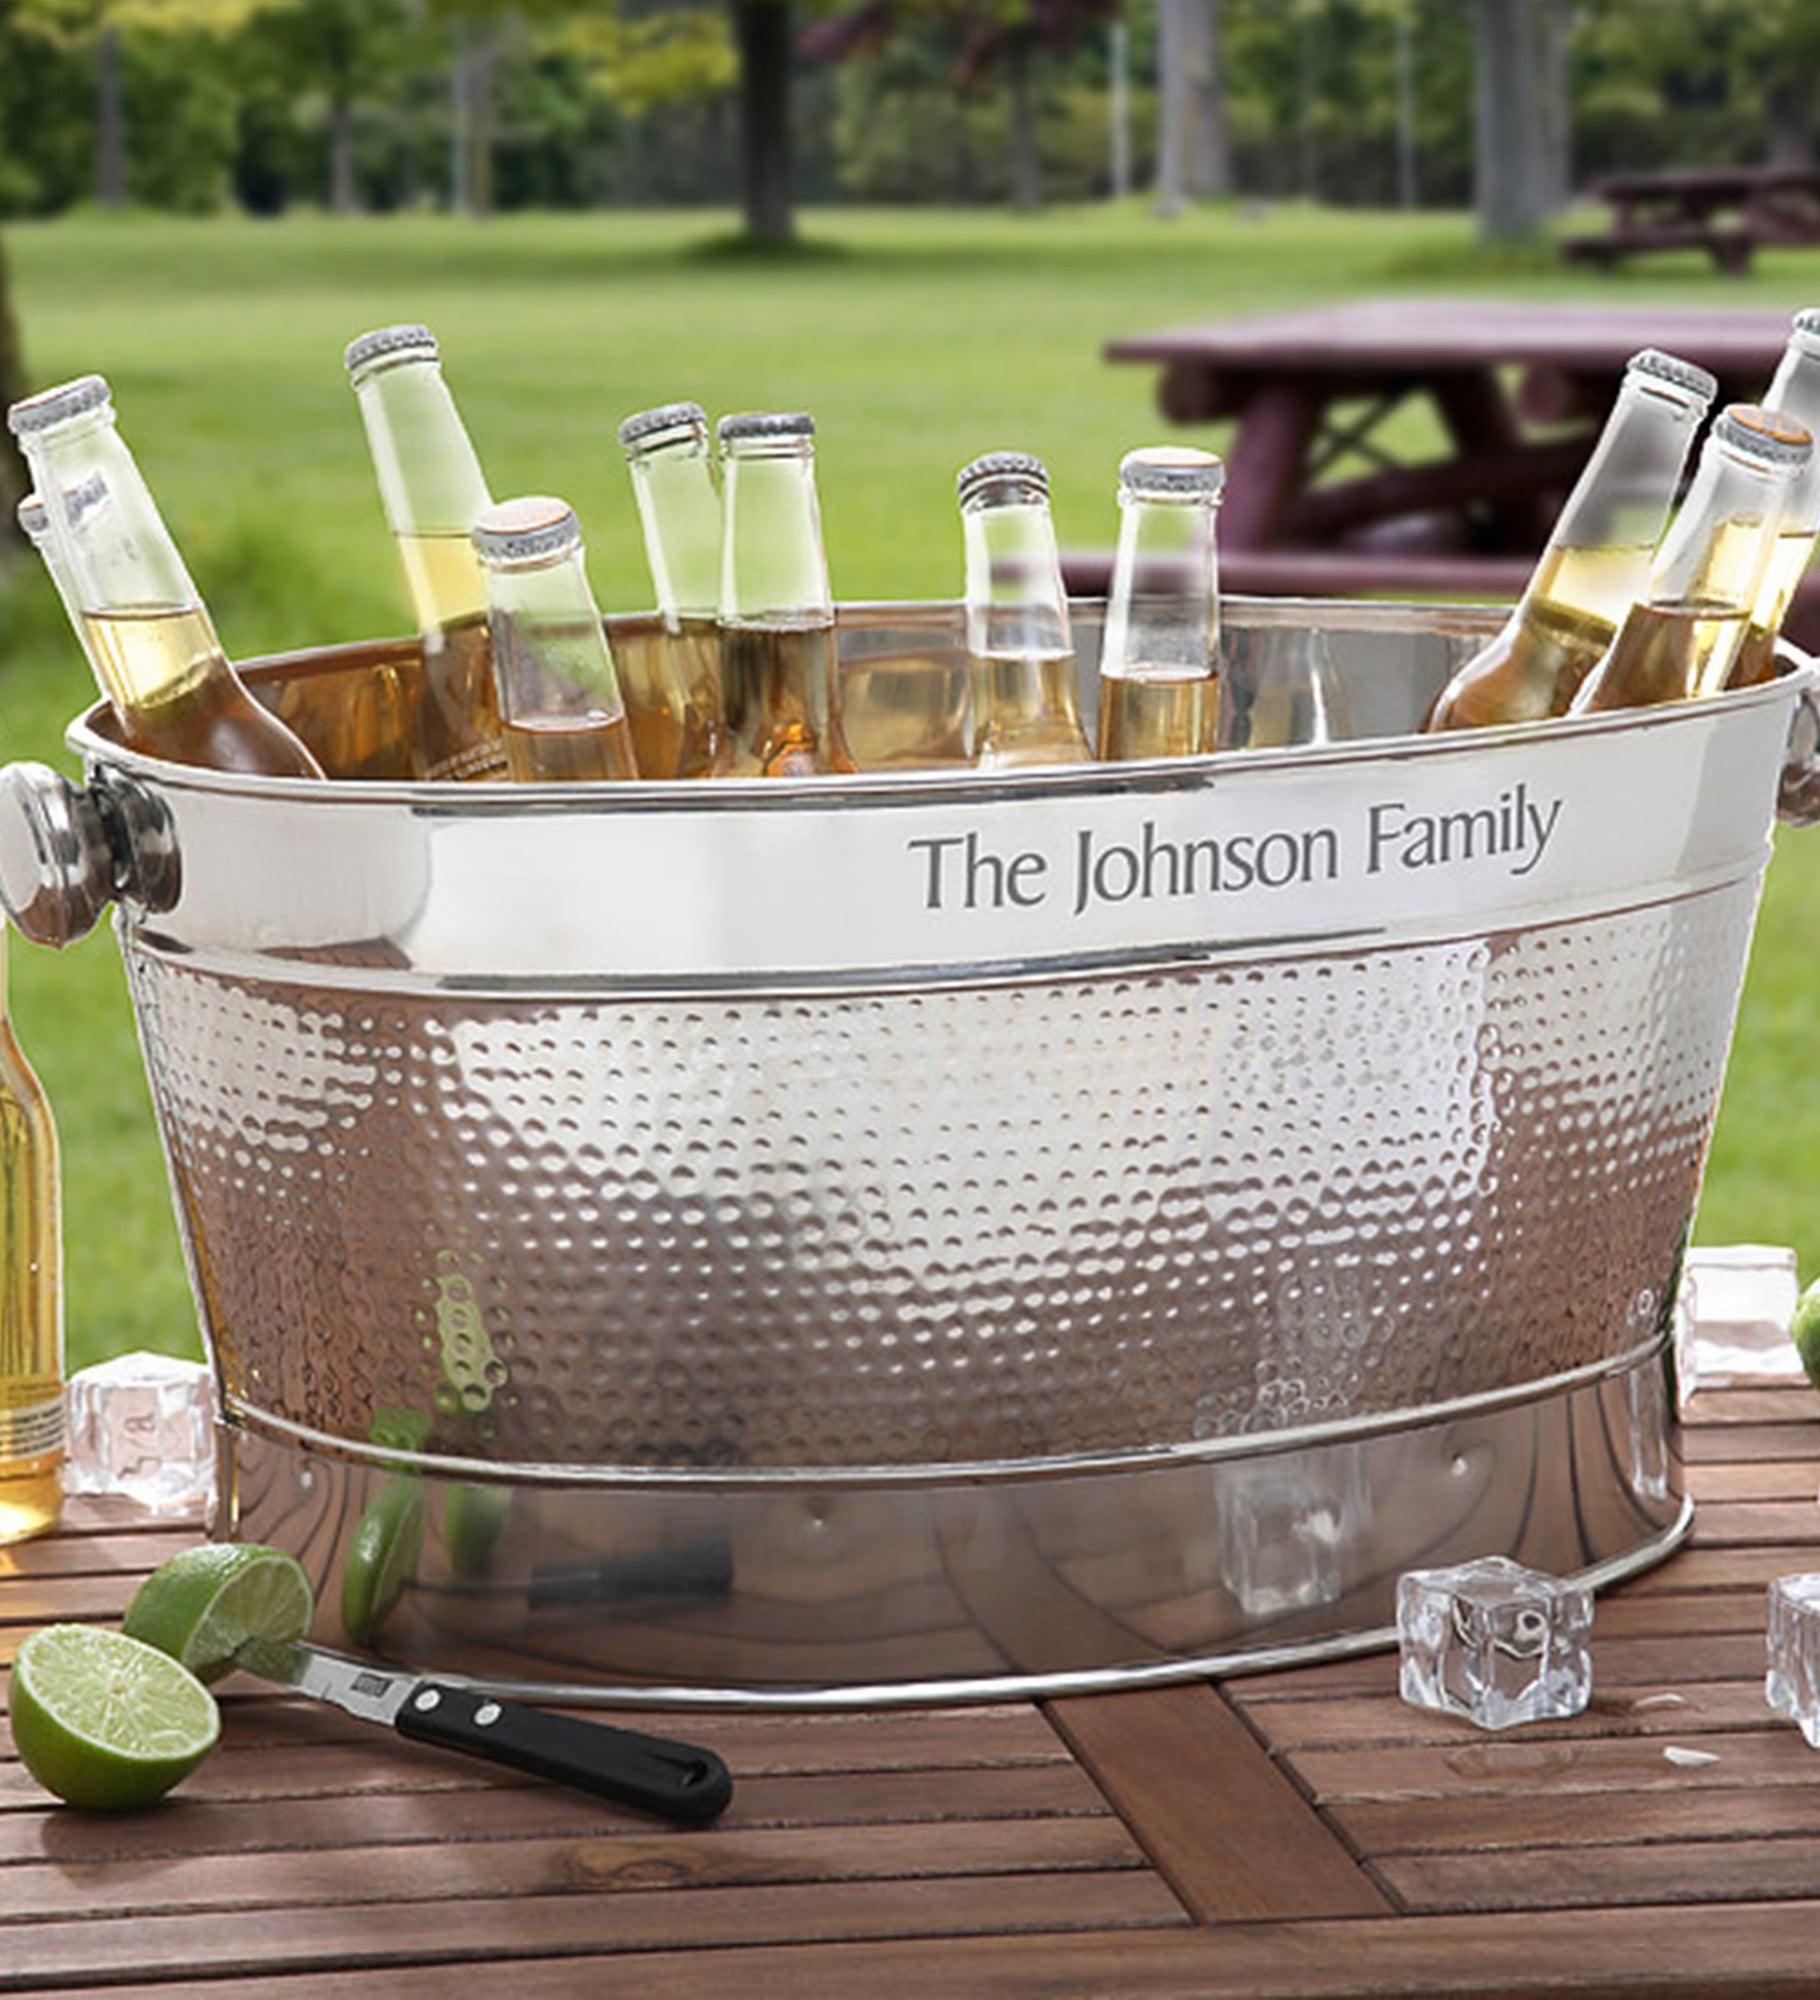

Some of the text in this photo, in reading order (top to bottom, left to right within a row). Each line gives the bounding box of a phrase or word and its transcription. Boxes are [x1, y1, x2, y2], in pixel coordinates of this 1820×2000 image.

[907, 782, 1563, 916] The Johnson Family
